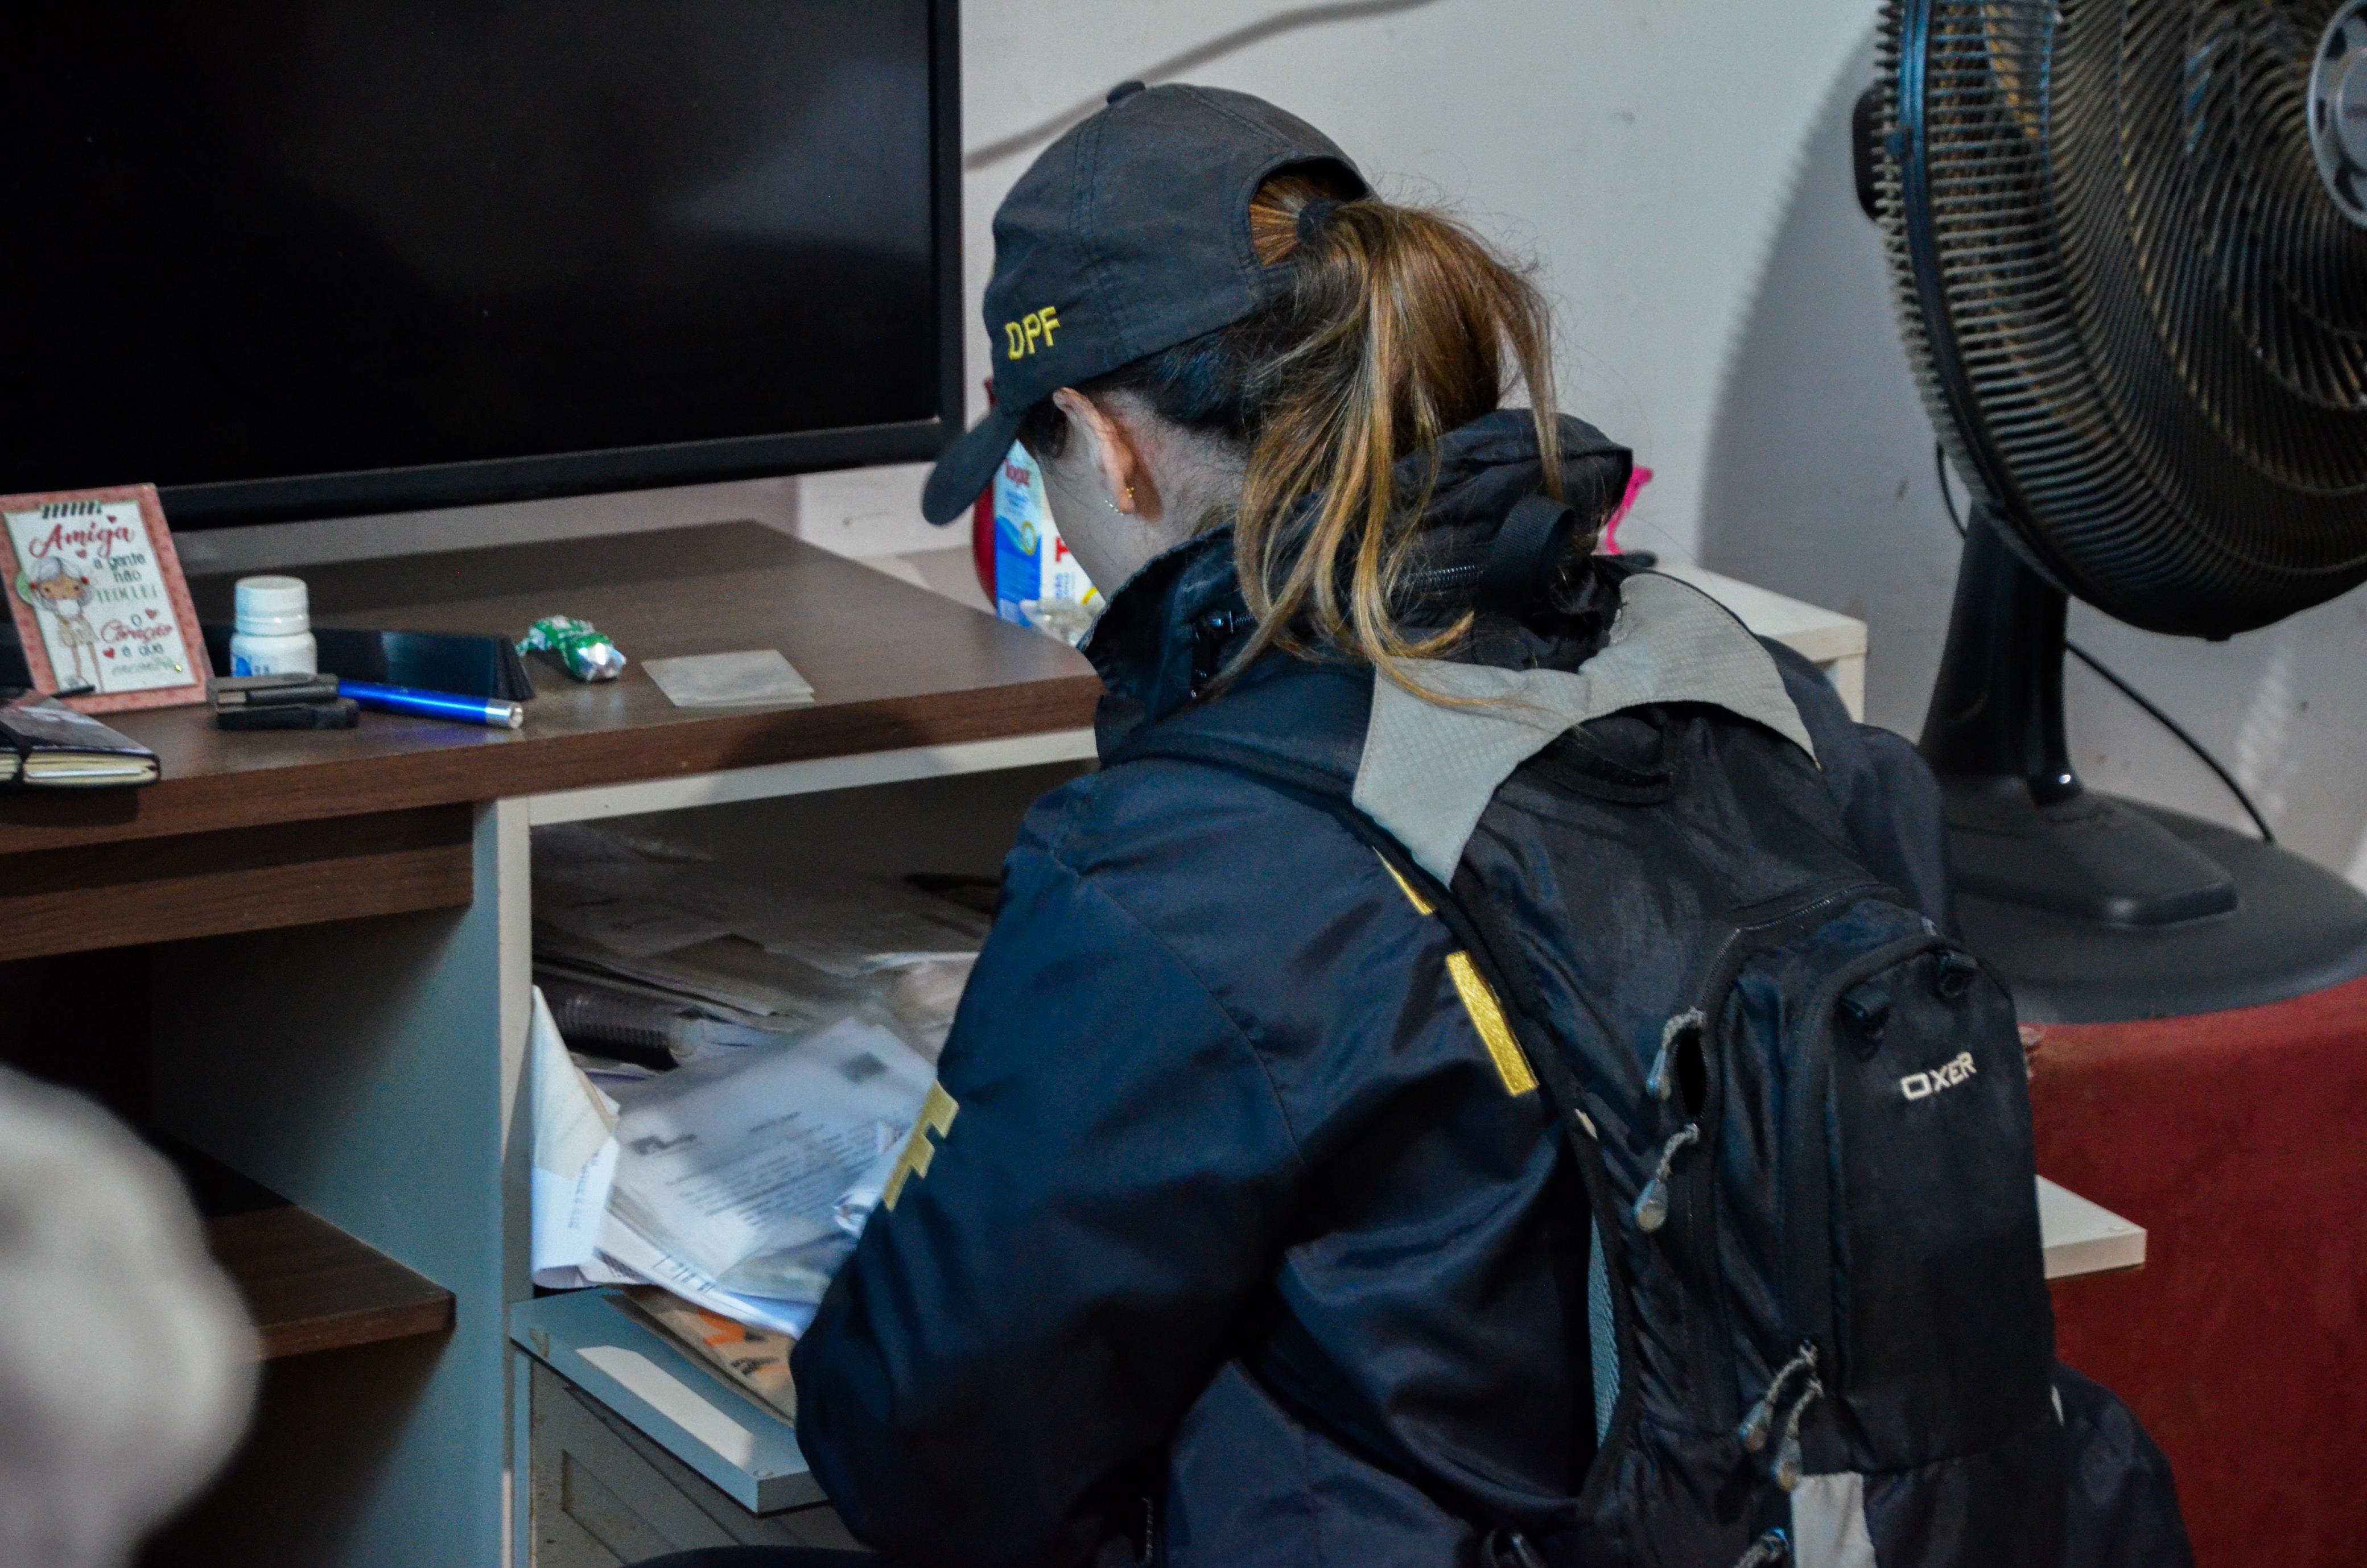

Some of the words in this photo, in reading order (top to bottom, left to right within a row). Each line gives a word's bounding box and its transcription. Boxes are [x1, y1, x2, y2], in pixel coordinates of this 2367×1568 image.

[1005, 306, 1061, 360] DPF
[29, 521, 134, 559] Amiga
[1901, 1051, 1977, 1101] OXER
